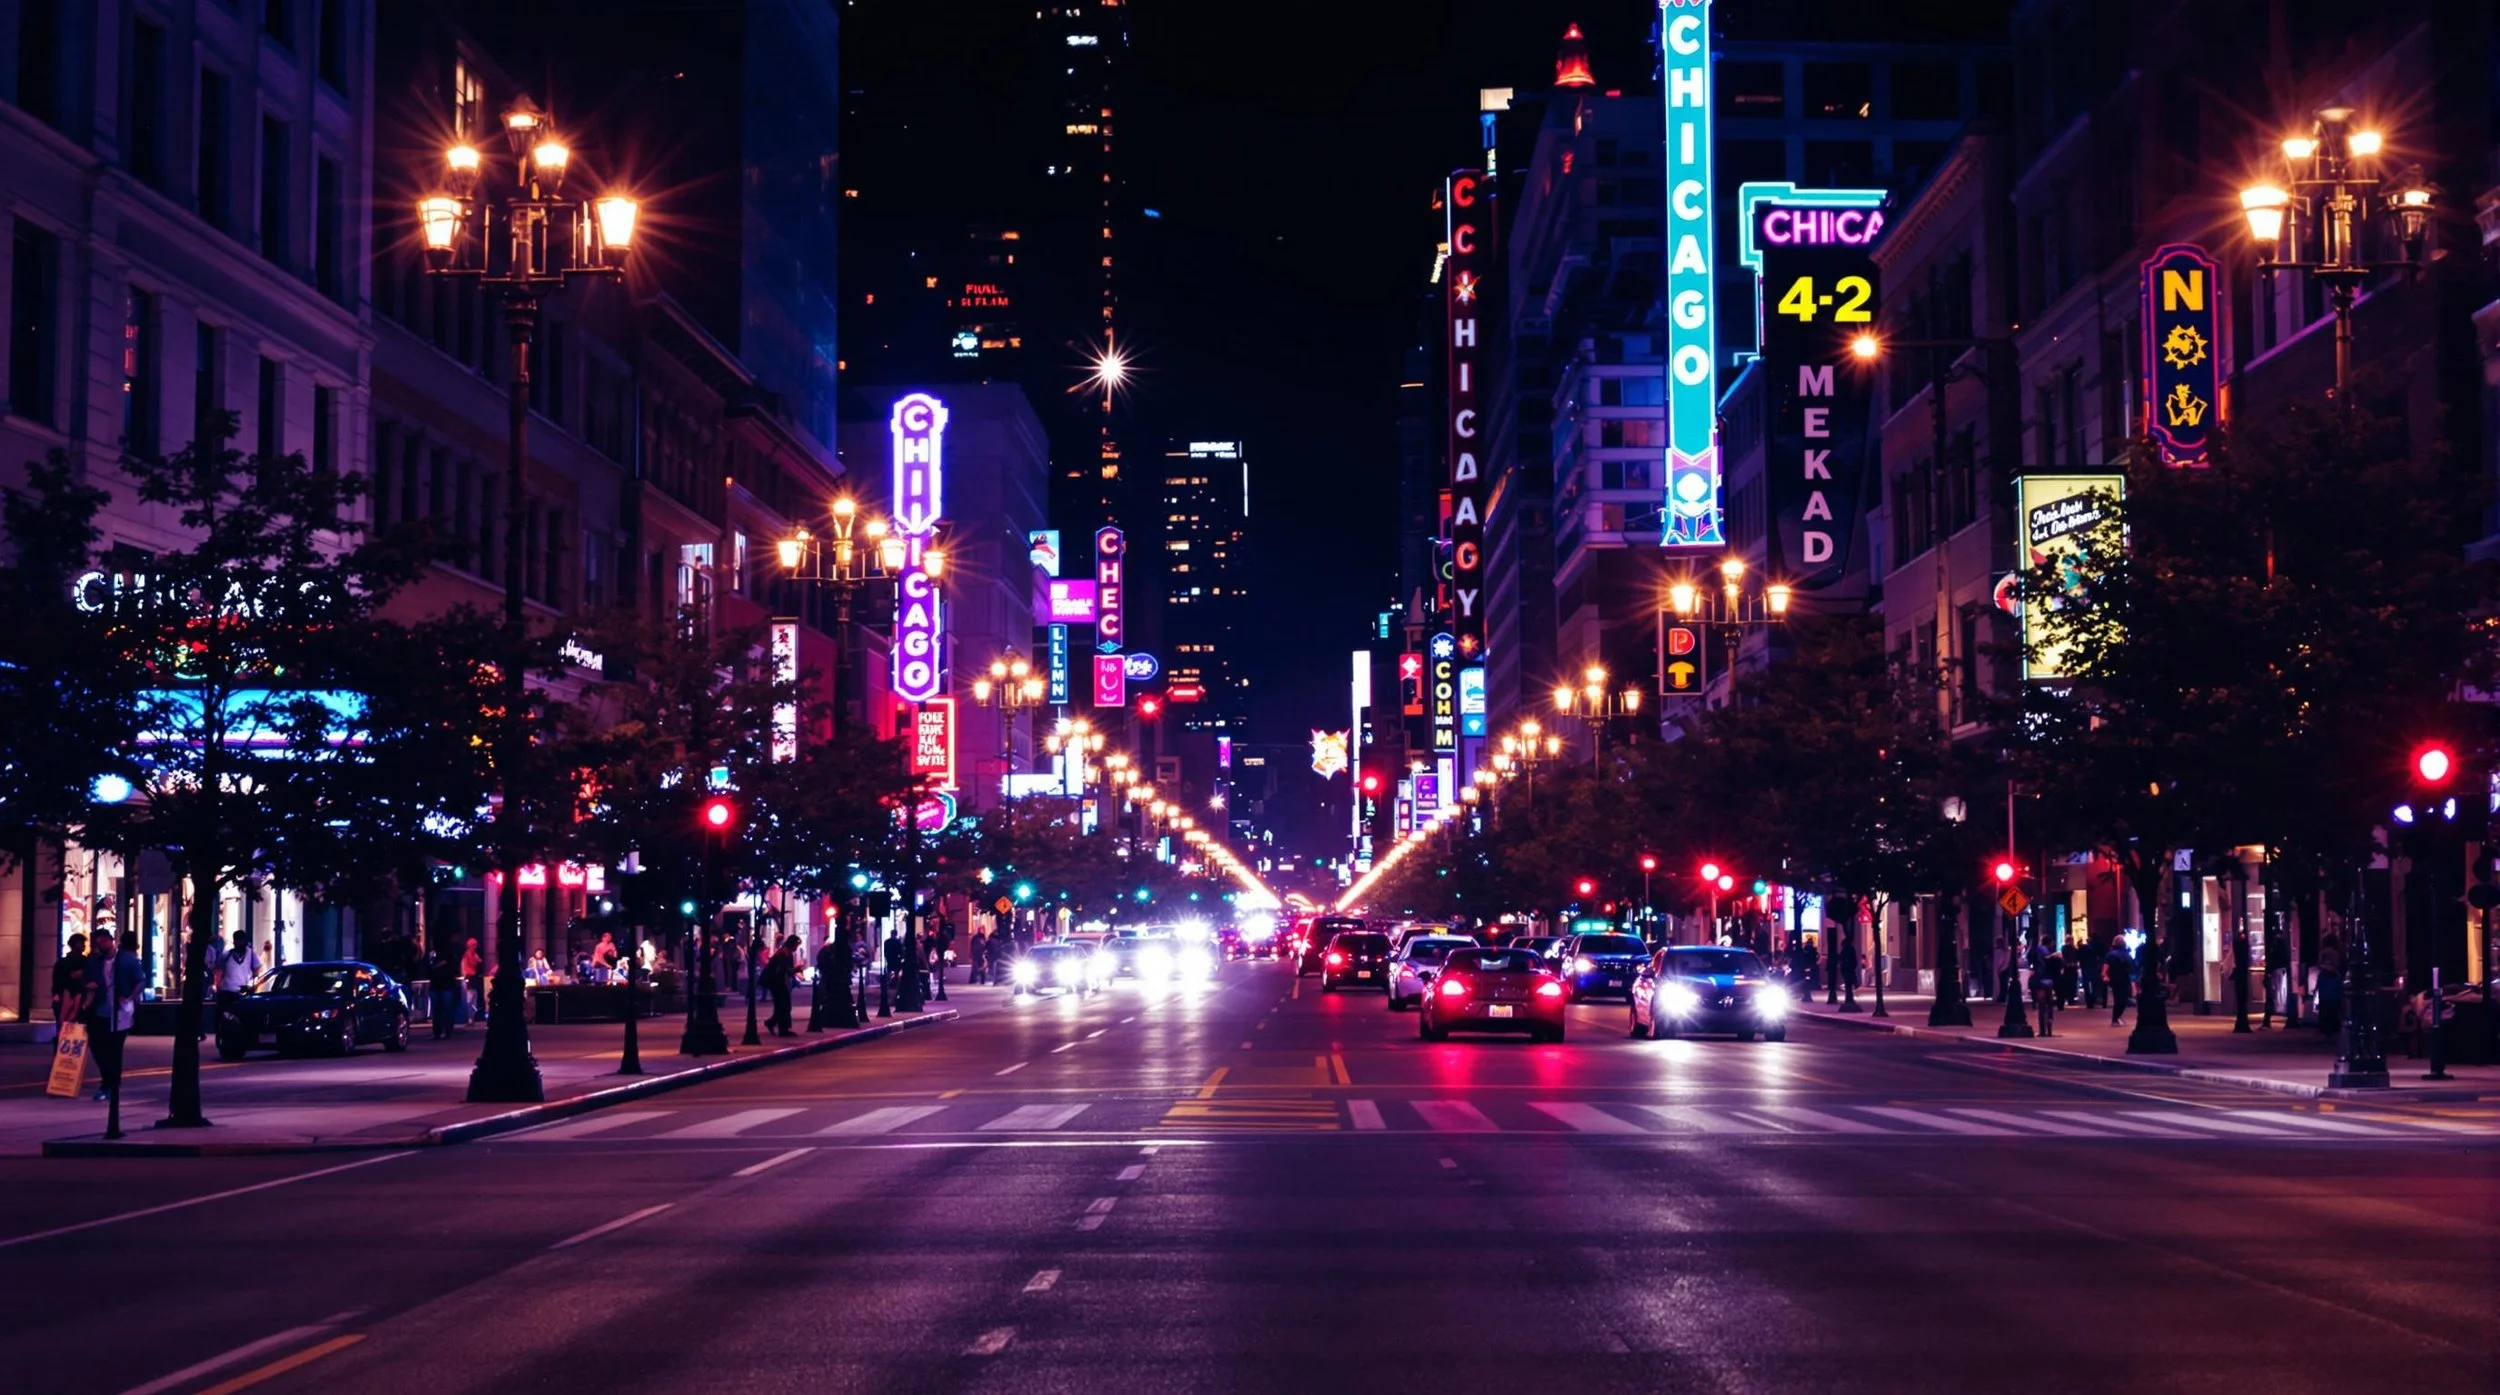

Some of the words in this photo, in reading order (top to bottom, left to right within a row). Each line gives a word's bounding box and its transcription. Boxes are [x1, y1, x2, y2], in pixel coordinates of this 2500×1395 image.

[1669, 14, 1710, 386] CHICAGO
[1777, 275, 1872, 323] 4-2
[1799, 365, 1834, 564] MEKAD
[1100, 533, 1120, 636] CHEC
